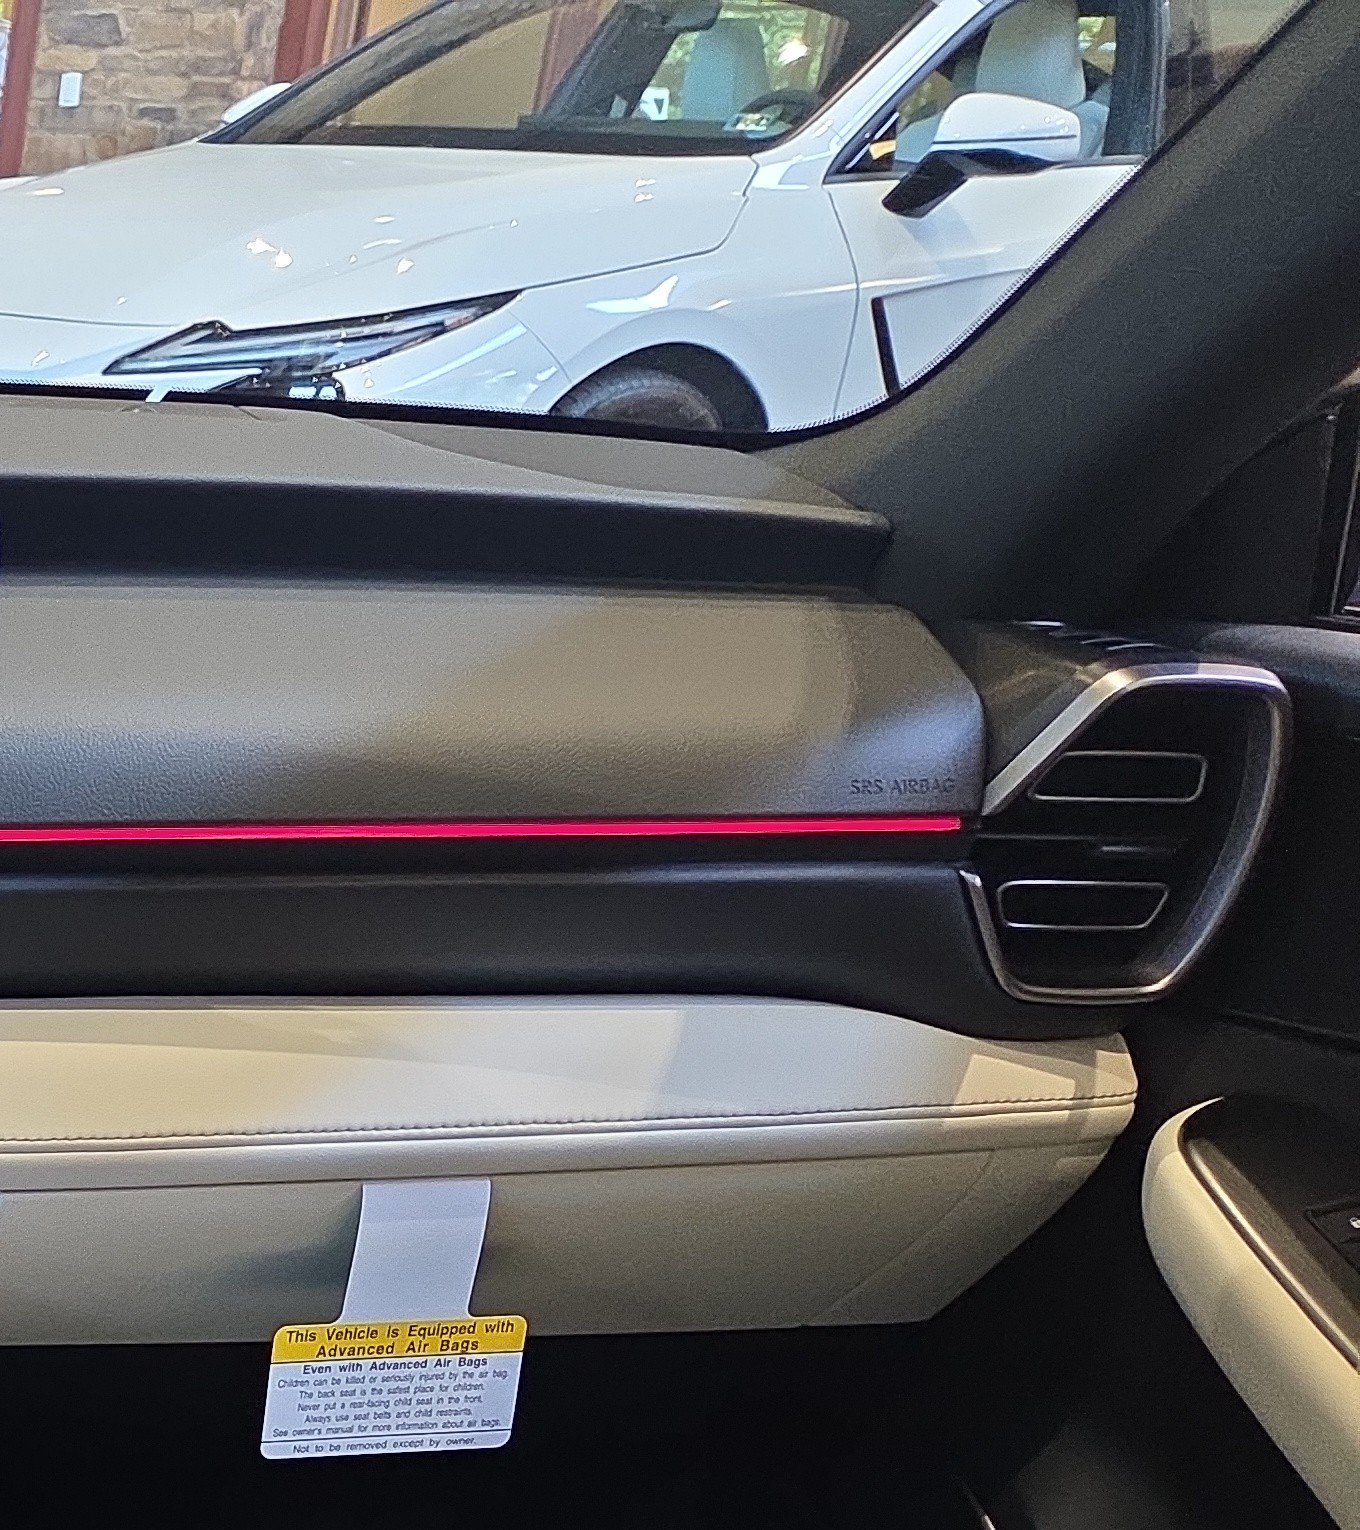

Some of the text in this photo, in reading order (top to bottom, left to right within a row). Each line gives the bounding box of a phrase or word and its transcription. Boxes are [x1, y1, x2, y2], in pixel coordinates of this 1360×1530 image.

[850, 777, 956, 795] SRS AIRBAG
[286, 1320, 515, 1343] This Vehicle is Equipped with
[316, 1339, 479, 1358] Advanced Air Bags
[303, 1356, 488, 1375] Even with Advanced Air Bags
[278, 1379, 309, 1388] Children
[331, 1377, 341, 1385] be
[345, 1375, 366, 1384] killed
[381, 1373, 416, 1384] seriously
[420, 1372, 445, 1382] injured
[448, 1371, 458, 1381] by
[462, 1370, 474, 1378] the
[478, 1371, 488, 1379] air
[299, 1390, 314, 1399] The
[317, 1389, 336, 1398] back
[340, 1388, 357, 1397] seat
[360, 1387, 366, 1396] is
[371, 1387, 383, 1395] the
[387, 1385, 410, 1395] safest
[413, 1384, 435, 1395] place
[440, 1383, 450, 1392] for
[297, 1402, 320, 1412] Never
[324, 1402, 336, 1412] put
[349, 1399, 390, 1409] rear-facing
[394, 1397, 412, 1406] child
[416, 1396, 432, 1405] seat
[437, 1396, 444, 1404] in
[448, 1395, 460, 1404] the
[304, 1414, 331, 1424] Always
[353, 1412, 370, 1421] seat
[373, 1411, 391, 1420] belts
[396, 1409, 410, 1418] and
[414, 1408, 432, 1417] child
[273, 1428, 288, 1437] See
[292, 1426, 322, 1436] owner's
[326, 1424, 354, 1434] manual
[357, 1424, 369, 1432] for
[395, 1421, 438, 1430] information
[442, 1419, 464, 1428] about
[467, 1419, 477, 1428] air
[293, 1437, 477, 1454] Not to be removed except by owner.
